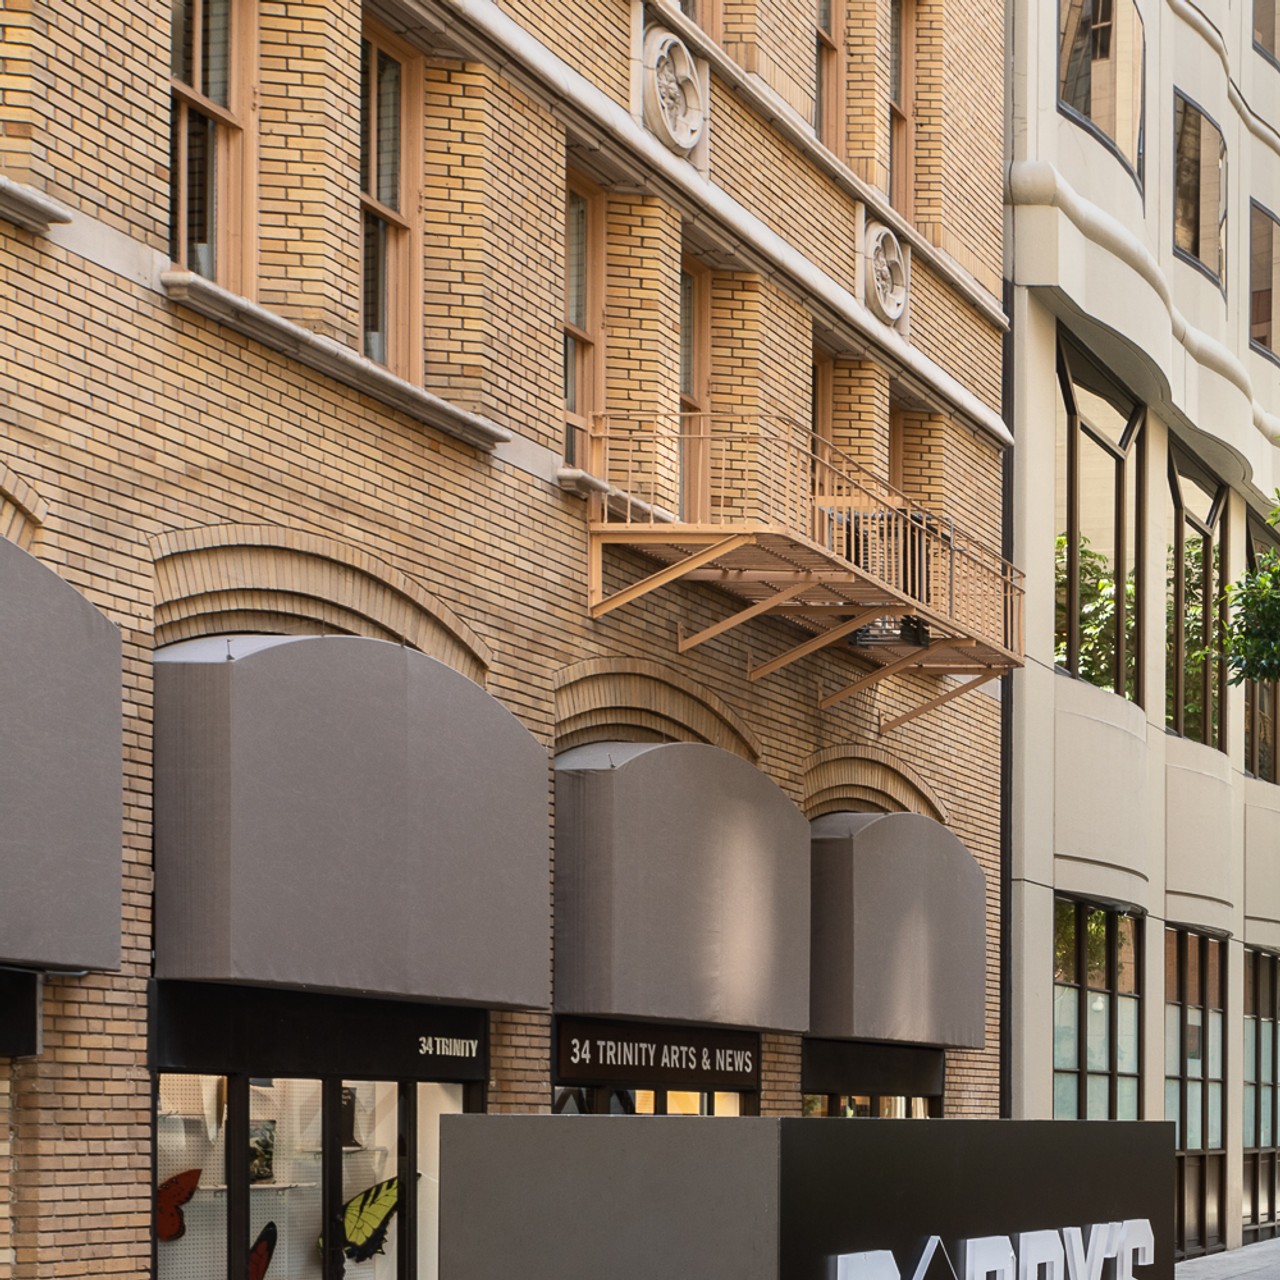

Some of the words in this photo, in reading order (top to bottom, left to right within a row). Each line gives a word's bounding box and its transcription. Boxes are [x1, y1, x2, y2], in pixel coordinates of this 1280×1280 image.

[418, 1036, 434, 1055] 34
[434, 1037, 479, 1058] TRINITY
[570, 1038, 591, 1064] 34
[597, 1040, 657, 1067] TRINITY
[660, 1044, 697, 1070] ARTS
[701, 1047, 711, 1071] &
[715, 1048, 753, 1073] NEWS
